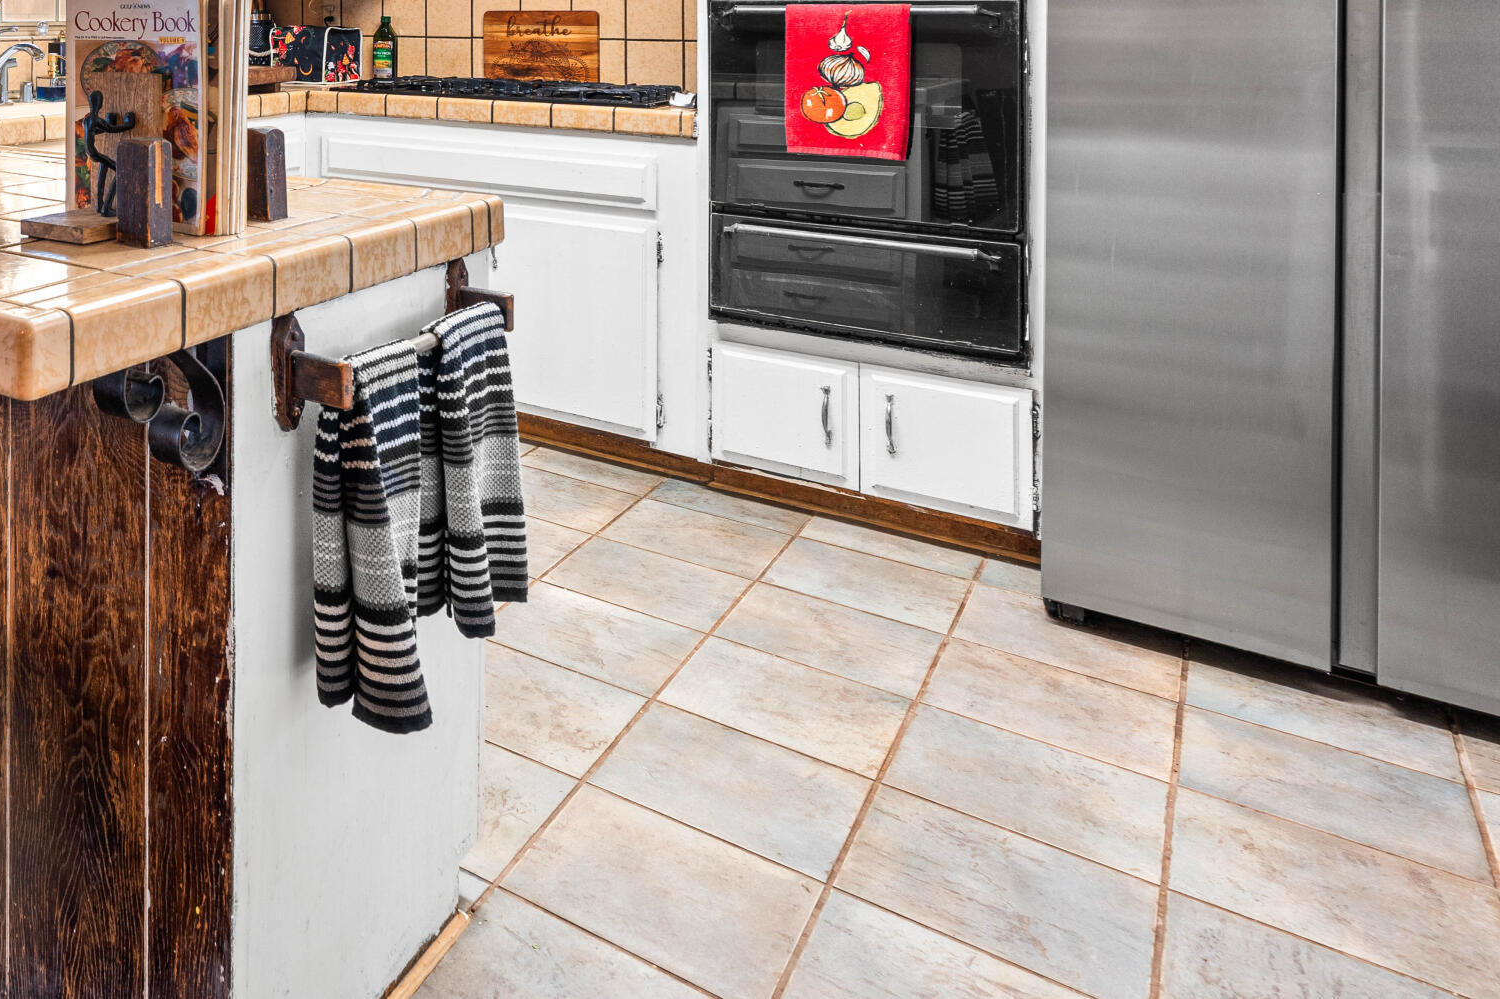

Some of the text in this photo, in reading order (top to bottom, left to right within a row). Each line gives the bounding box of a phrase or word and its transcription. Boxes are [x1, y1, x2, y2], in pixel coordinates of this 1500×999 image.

[74, 9, 197, 40] Cookery Book
[506, 15, 572, 37] breathe
